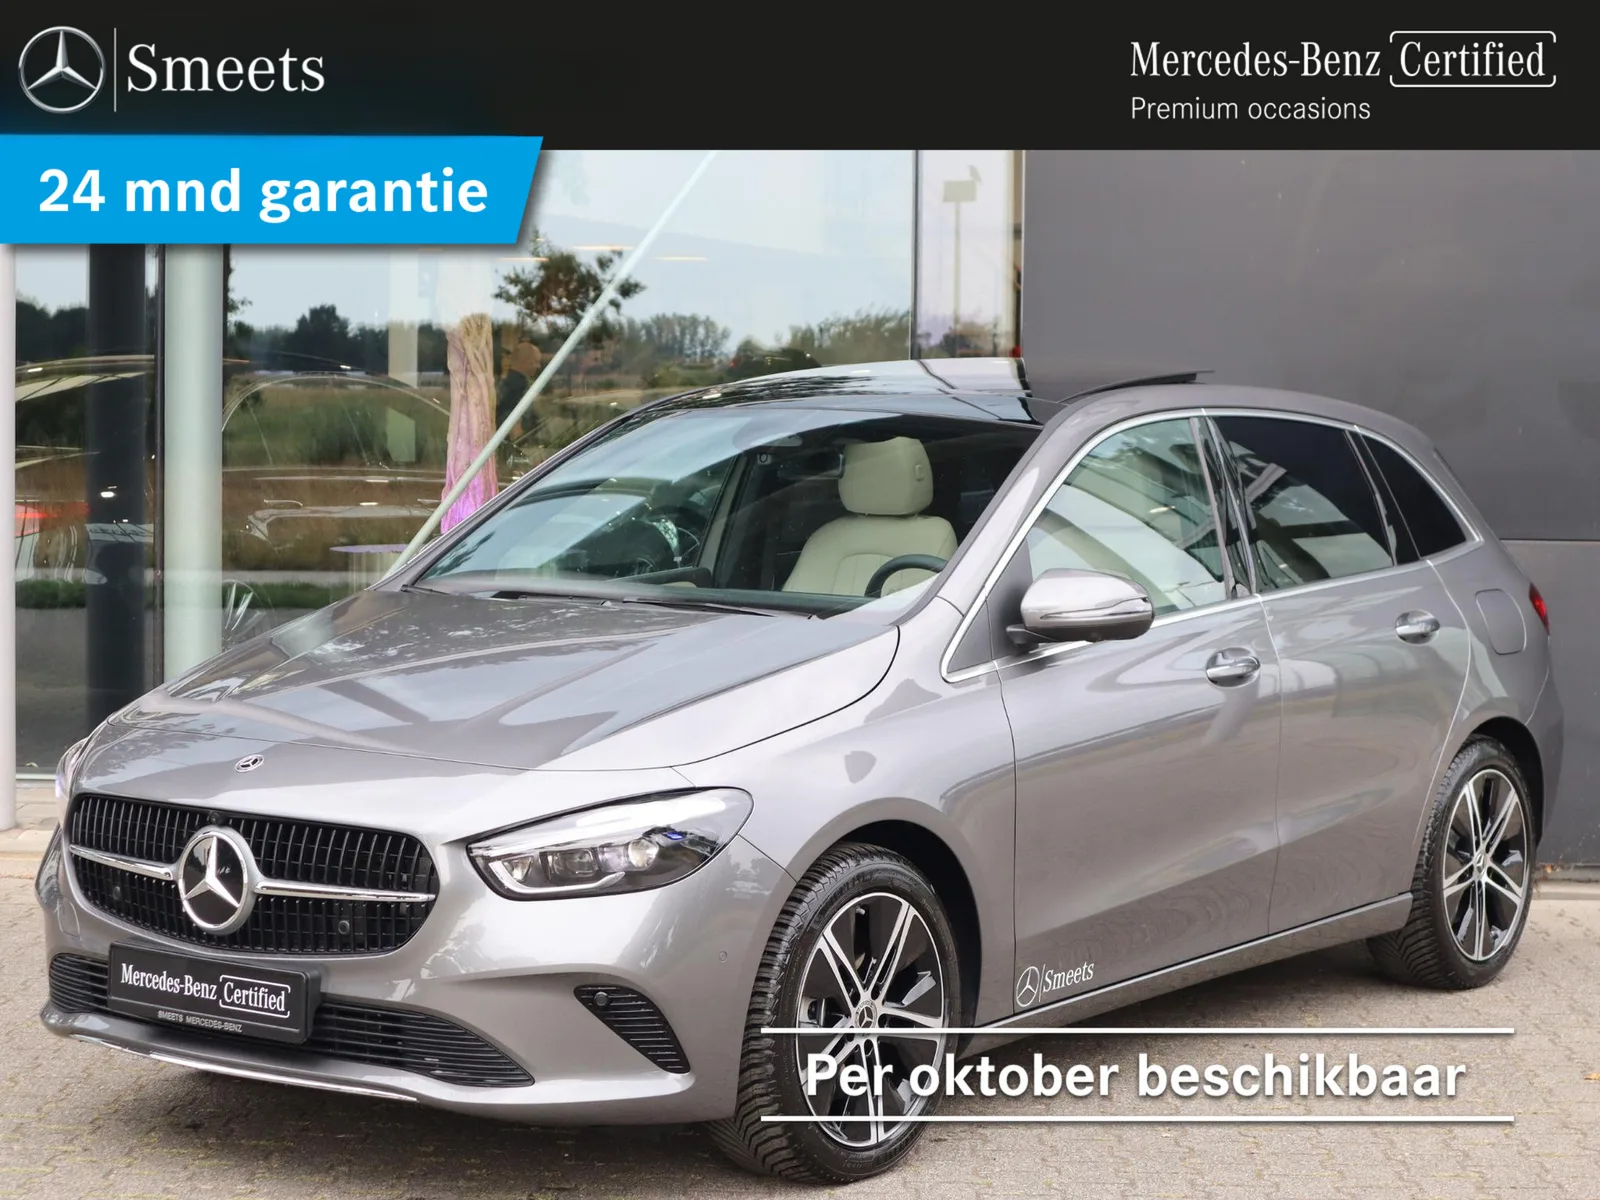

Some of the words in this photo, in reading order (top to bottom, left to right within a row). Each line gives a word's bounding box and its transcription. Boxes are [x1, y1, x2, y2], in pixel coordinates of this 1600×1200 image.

[120, 963, 218, 1000] Mercedes-Benz
[223, 981, 286, 1012] Certified
[1042, 961, 1095, 993] Smeets
[157, 1010, 184, 1022] SMEETS
[185, 1015, 243, 1033] MERCEDES-BENZ
